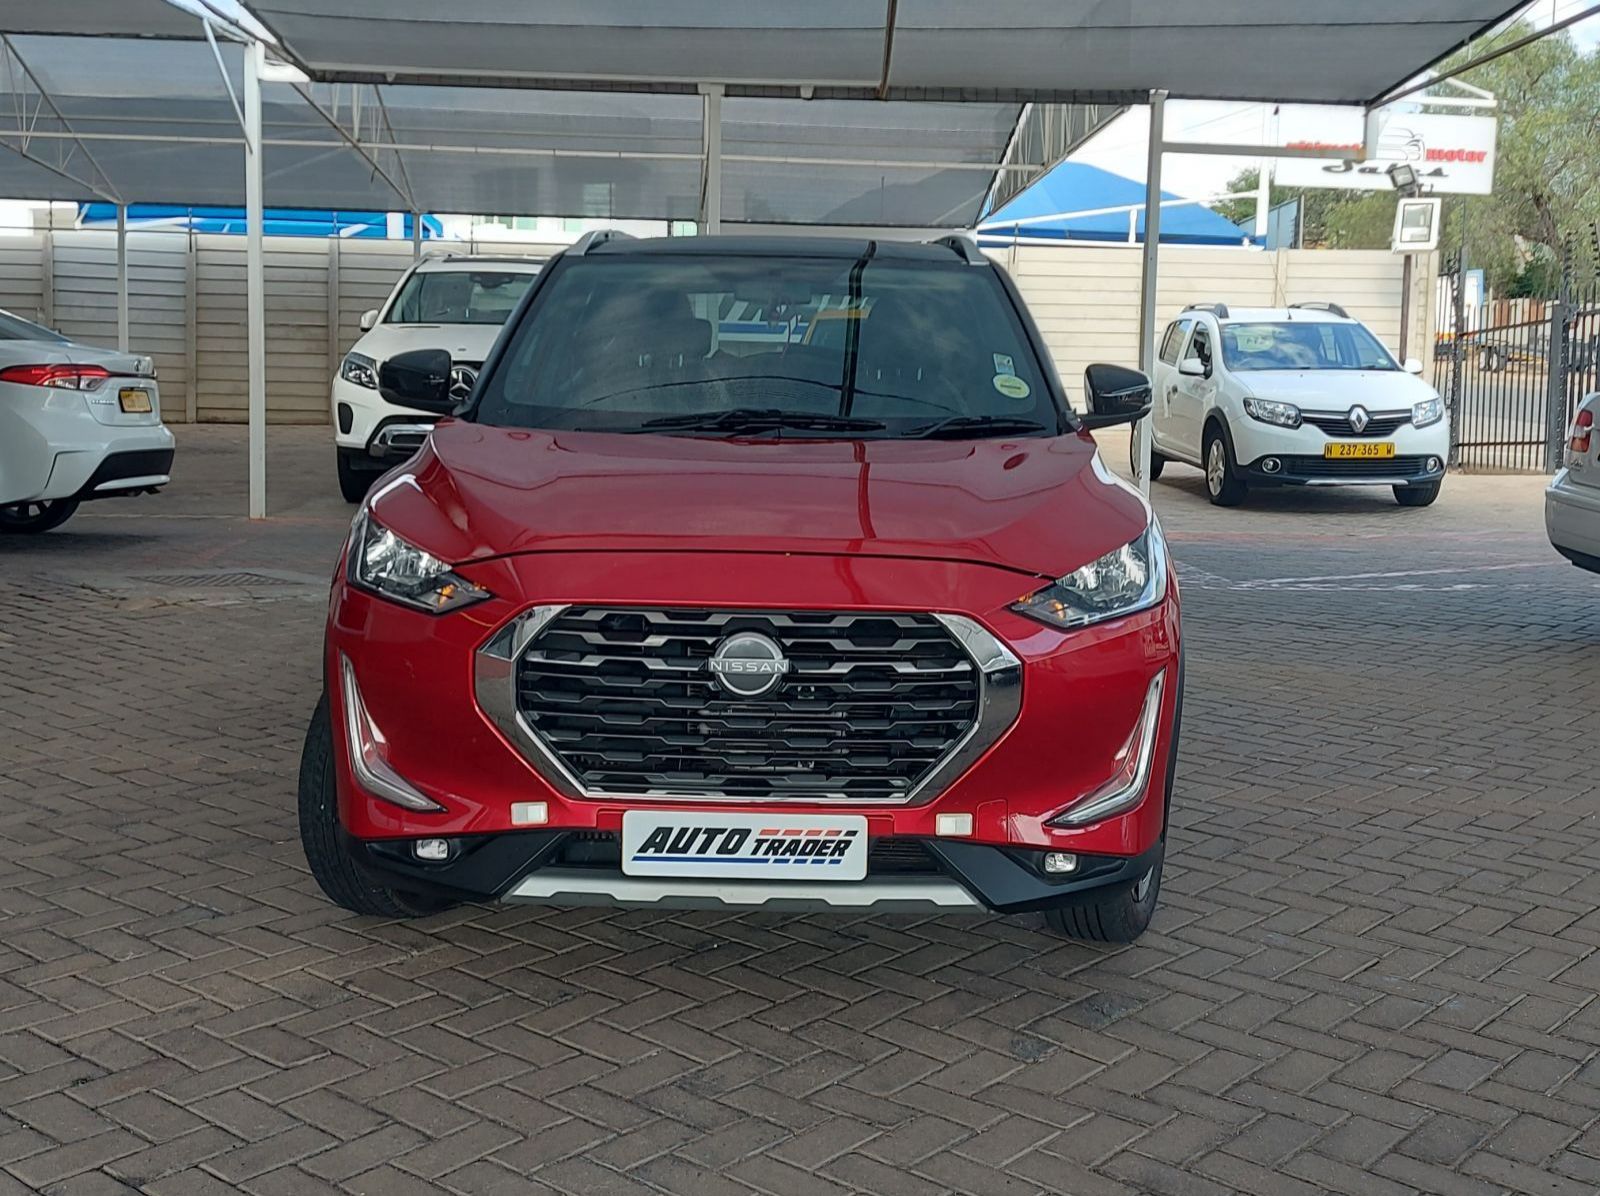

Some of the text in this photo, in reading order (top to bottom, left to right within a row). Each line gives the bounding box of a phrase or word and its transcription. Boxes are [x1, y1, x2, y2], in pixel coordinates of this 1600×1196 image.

[1426, 147, 1488, 163] motor
[1326, 445, 1333, 456] N
[1386, 444, 1392, 456] W
[710, 661, 787, 673] NISSAN
[637, 827, 853, 857] AUTO TRADER
